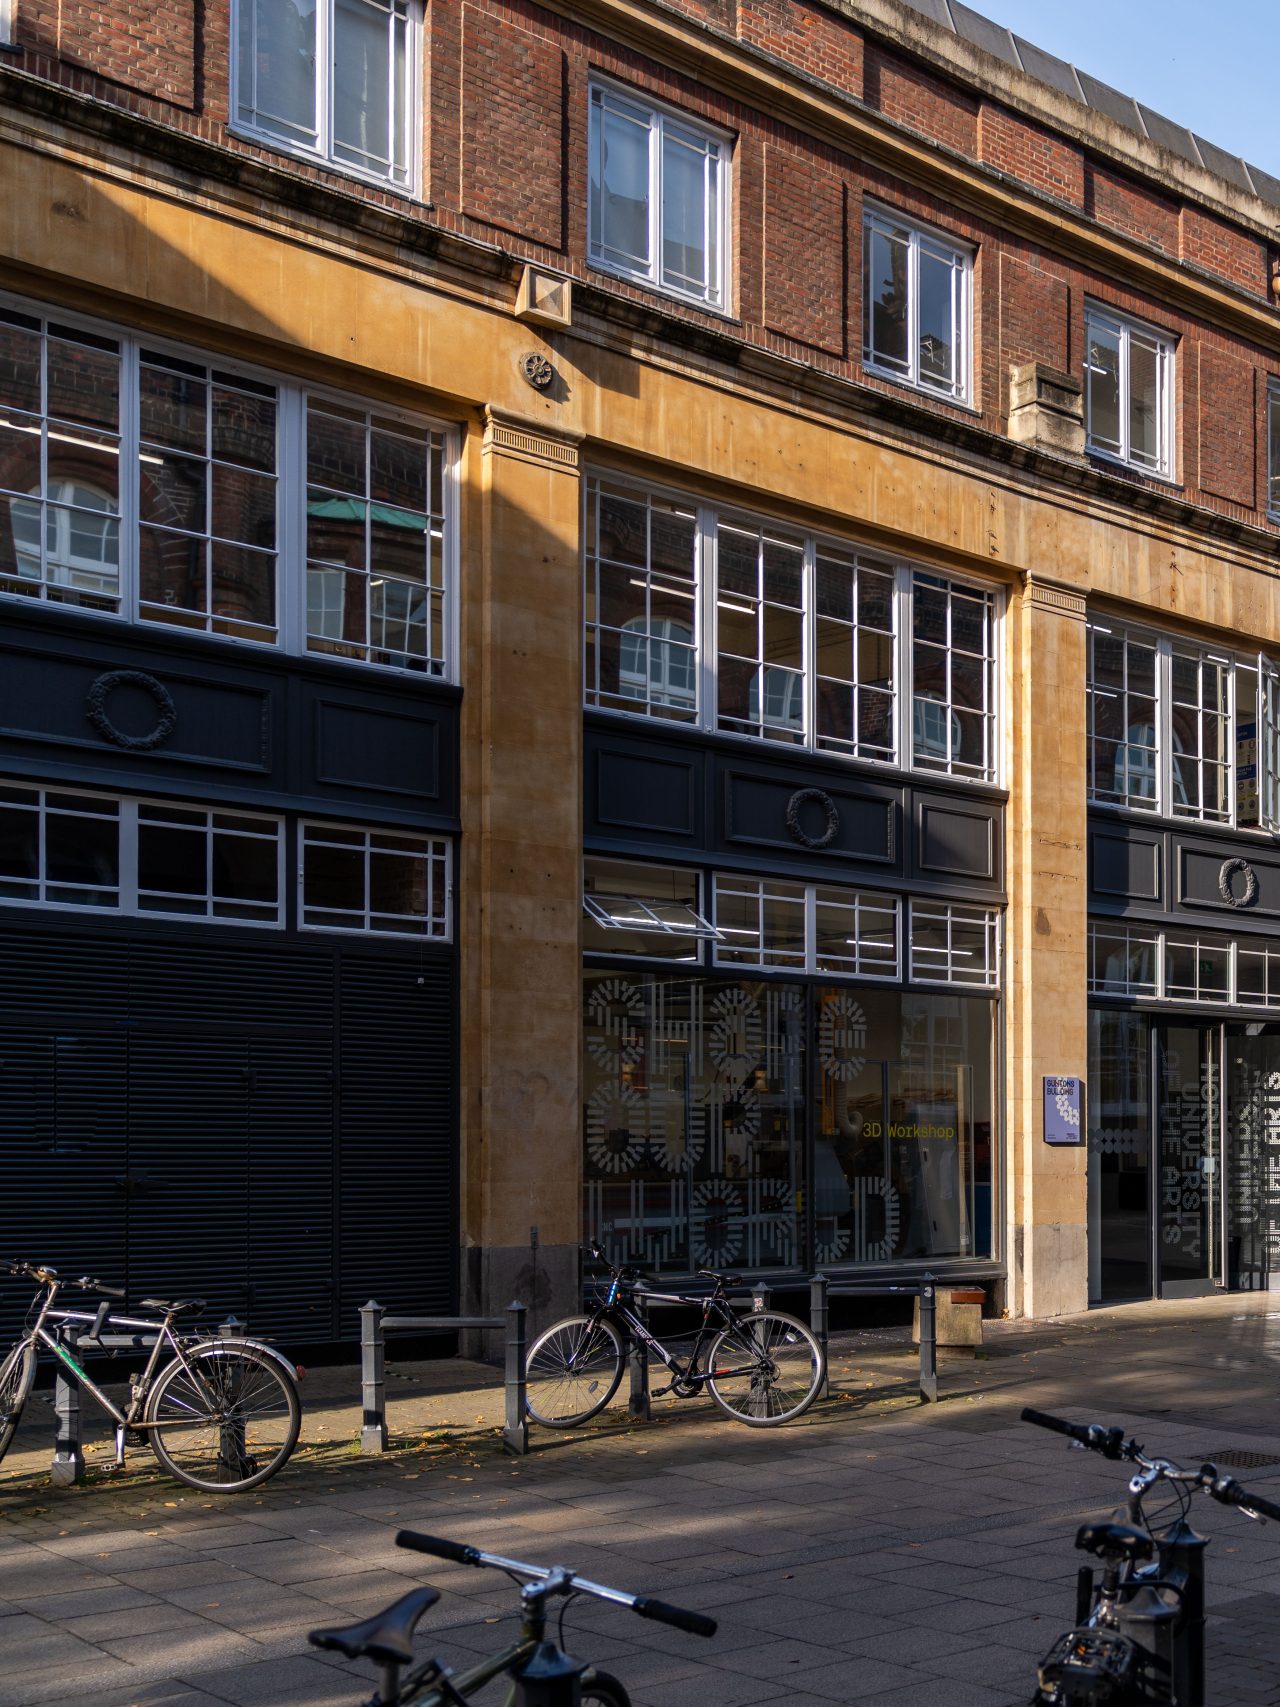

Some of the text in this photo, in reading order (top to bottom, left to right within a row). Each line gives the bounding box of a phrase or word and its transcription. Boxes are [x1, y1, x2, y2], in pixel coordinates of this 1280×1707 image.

[863, 1122, 955, 1141] 3D Workshop
[1162, 1049, 1181, 1245] OF THE ARTS
[1182, 1082, 1200, 1258] UNIVERSITY
